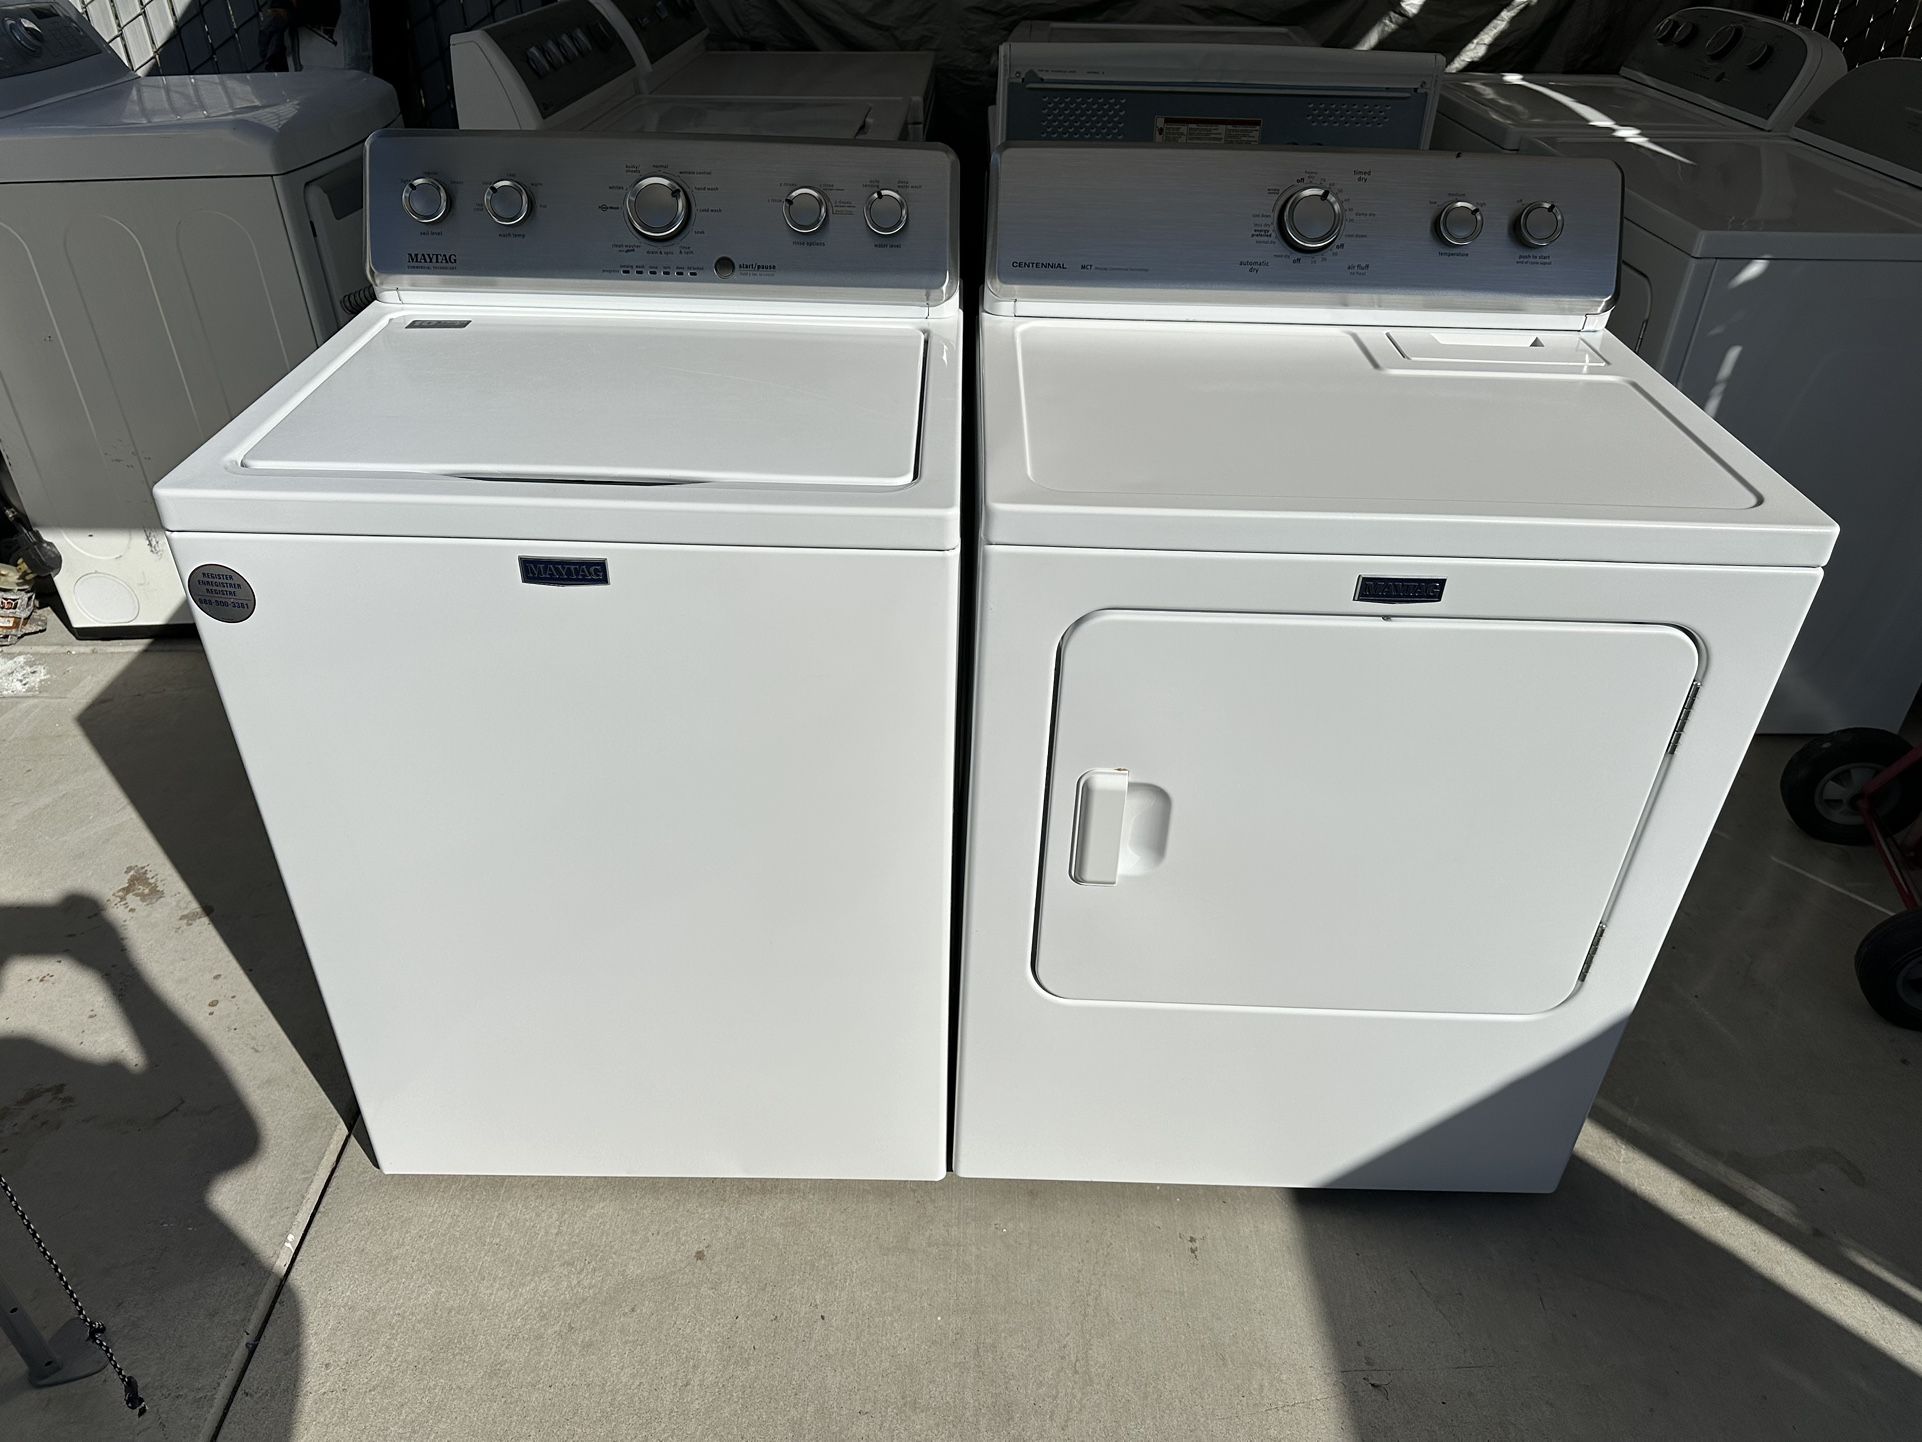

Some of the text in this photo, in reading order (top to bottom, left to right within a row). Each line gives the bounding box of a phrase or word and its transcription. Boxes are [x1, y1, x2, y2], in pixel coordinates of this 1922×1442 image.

[1353, 169, 1371, 177] timed
[1296, 177, 1305, 185] off
[1356, 176, 1368, 184] dry
[806, 240, 826, 249] options
[407, 253, 457, 264] MAYTAG
[1438, 250, 1469, 259] temperature
[1518, 253, 1531, 261] push
[1011, 261, 1068, 270] CENTENNIAL
[1239, 260, 1269, 268] automatic
[1292, 257, 1302, 265] off
[738, 262, 777, 271] start/pause
[1248, 266, 1260, 275] dry
[1347, 263, 1371, 271] air fluff
[526, 563, 603, 579] MAYTAG
[202, 572, 234, 581] REGISTER
[197, 579, 242, 590] ENREGISTRER
[206, 587, 237, 596] REGISTRE
